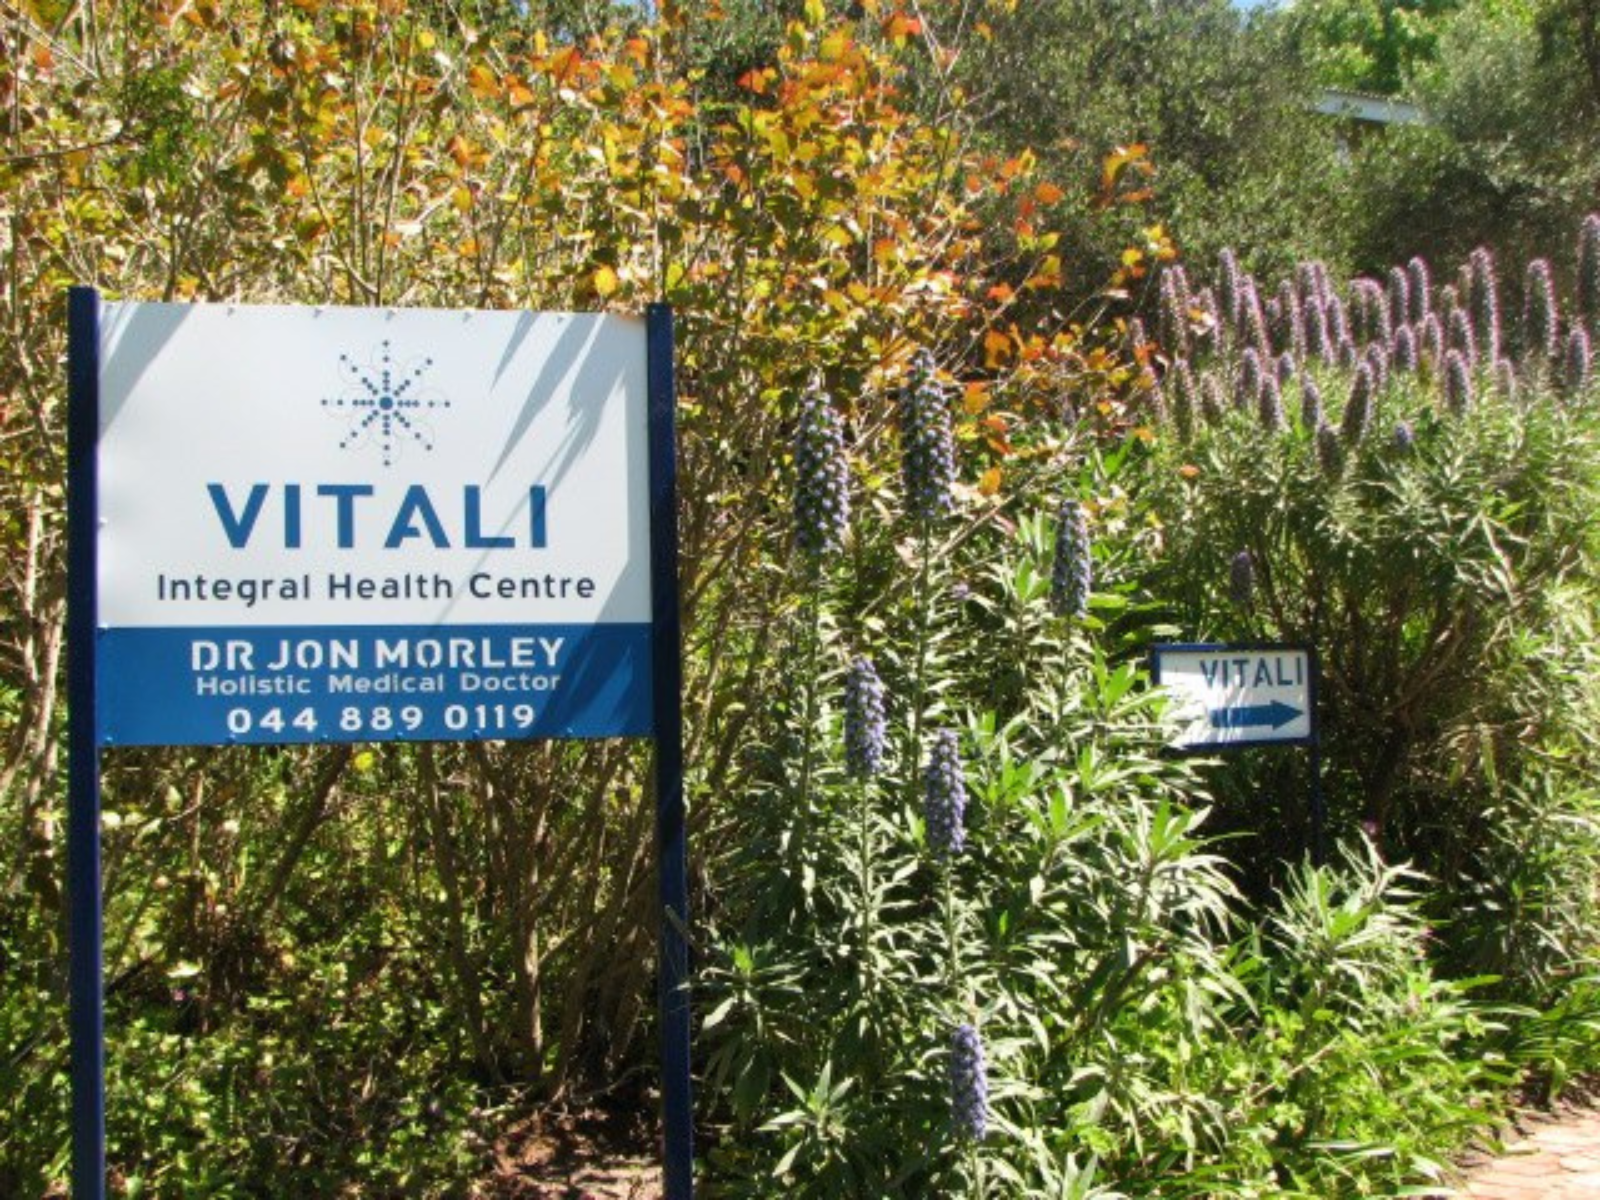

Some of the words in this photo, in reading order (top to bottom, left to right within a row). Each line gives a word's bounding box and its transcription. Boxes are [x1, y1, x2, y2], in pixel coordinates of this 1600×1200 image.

[206, 483, 549, 549] VITALI
[158, 574, 310, 607] Integral
[328, 573, 453, 600] Health
[469, 572, 597, 598] Centre
[190, 640, 255, 671] DR
[267, 639, 359, 670] JON
[376, 637, 566, 669] MORLEY
[196, 673, 312, 696] Holistic
[328, 672, 445, 695] Medical
[460, 671, 562, 693] Doctor
[1200, 657, 1304, 688] VITALI
[226, 706, 319, 734] 044
[340, 705, 424, 731] 889
[444, 704, 535, 729] 0119
